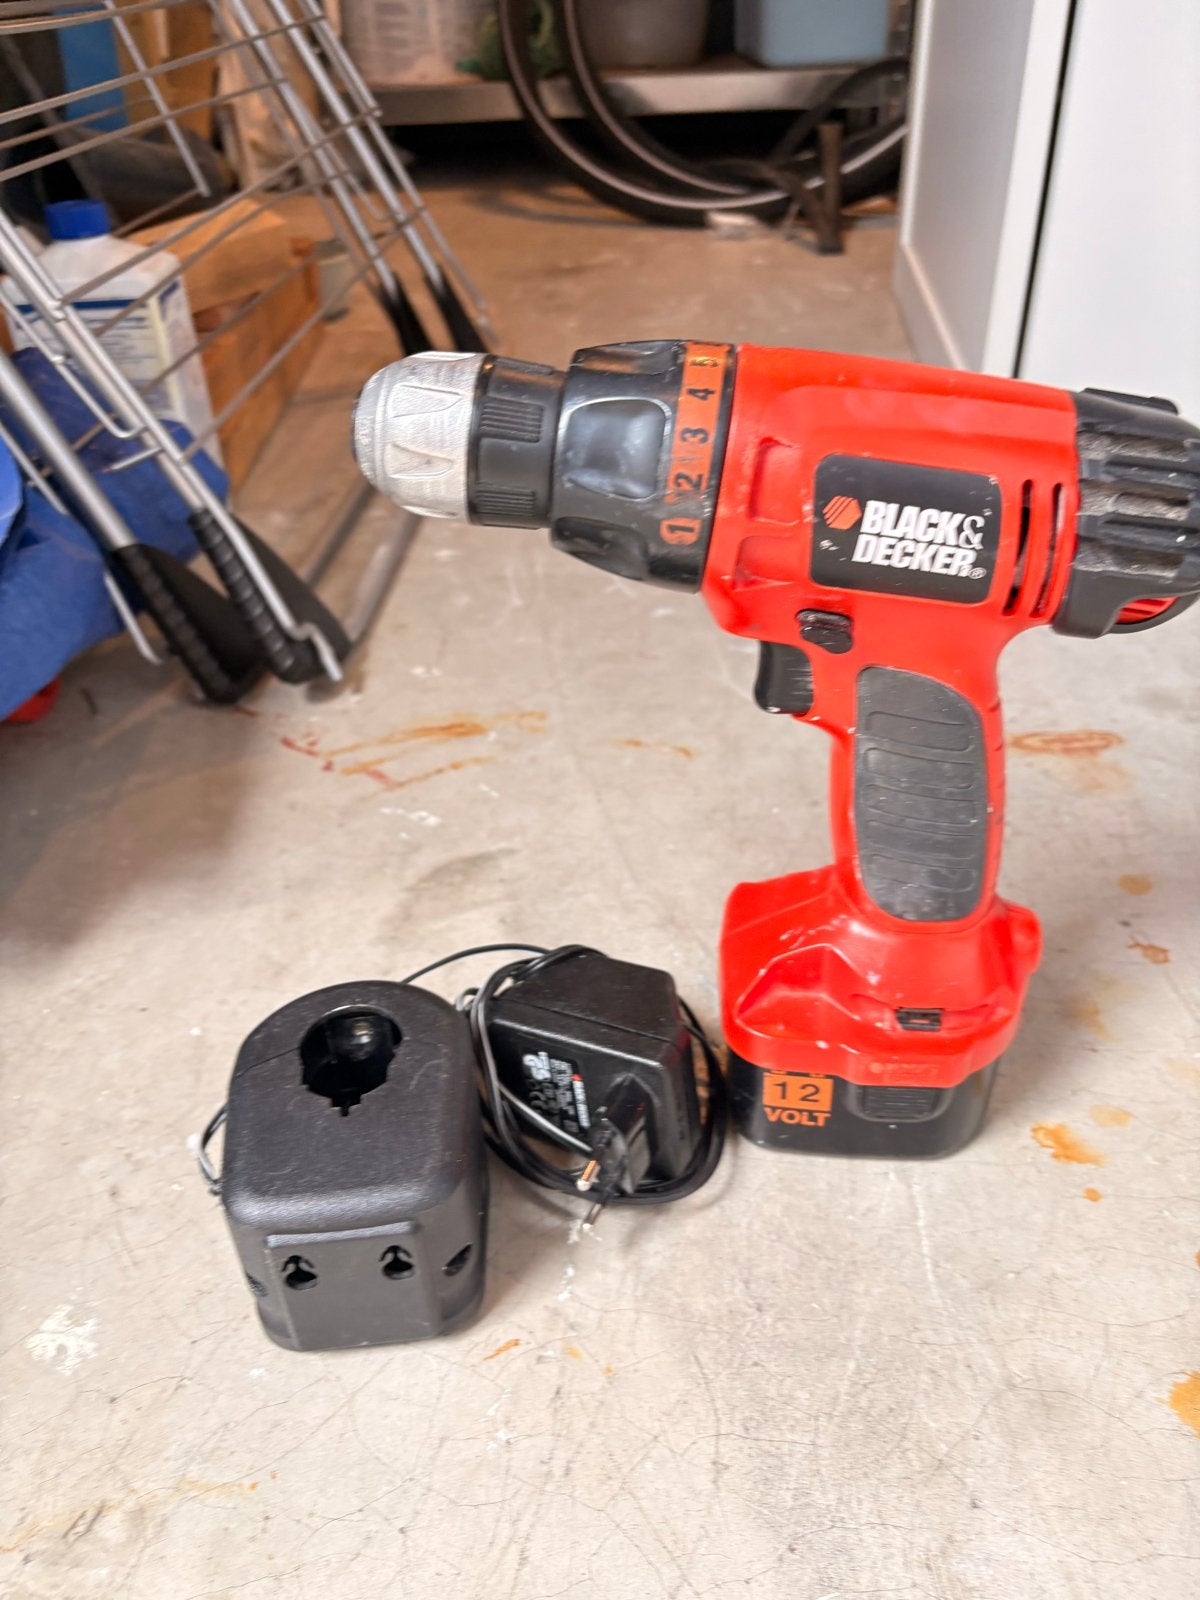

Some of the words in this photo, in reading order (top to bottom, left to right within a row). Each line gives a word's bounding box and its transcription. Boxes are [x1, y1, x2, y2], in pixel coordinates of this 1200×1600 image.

[686, 388, 716, 401] 4
[680, 427, 710, 444] 3
[674, 472, 704, 490] 2
[668, 522, 695, 534] 1
[859, 499, 986, 550] BLACK&
[772, 1080, 820, 1103] 12
[763, 1107, 832, 1127] VOLT
